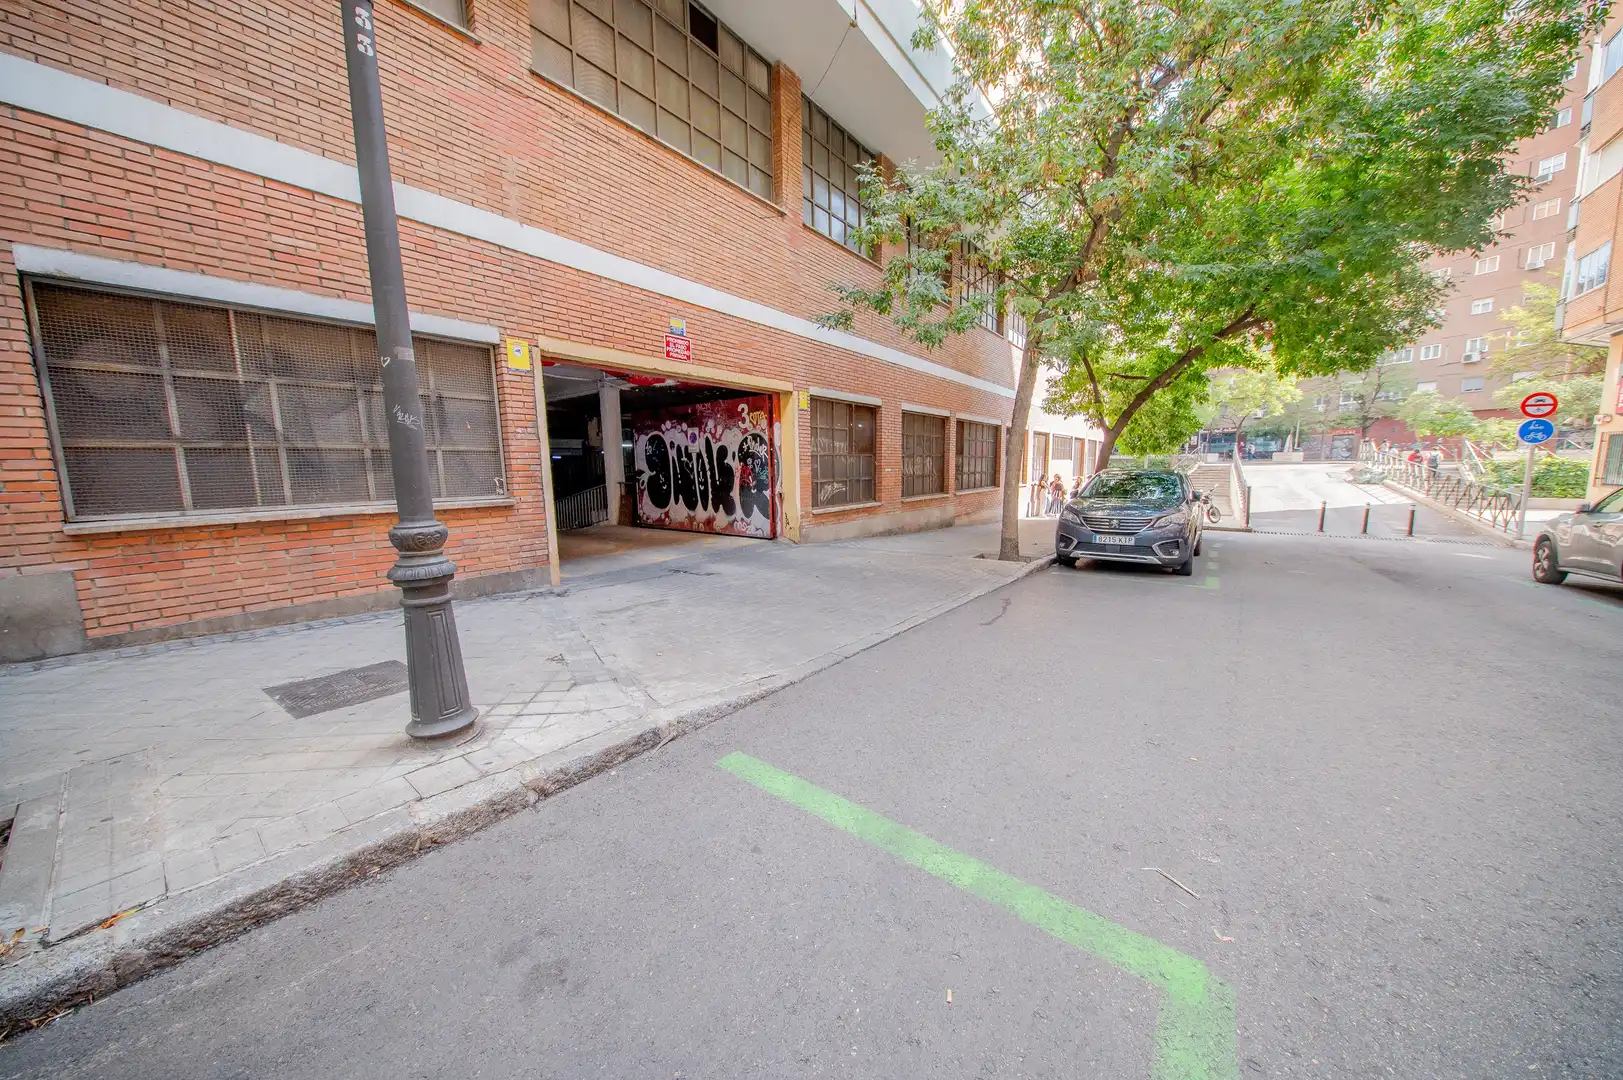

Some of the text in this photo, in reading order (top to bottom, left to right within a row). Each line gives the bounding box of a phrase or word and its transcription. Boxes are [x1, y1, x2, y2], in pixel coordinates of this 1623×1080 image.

[666, 337, 689, 346] PROHIBIDO
[666, 346, 690, 356] PROPIEDAD
[676, 343, 687, 351] PASO
[669, 352, 688, 360] PRIVADA
[737, 403, 750, 429] 3
[1098, 535, 1117, 543] 8215
